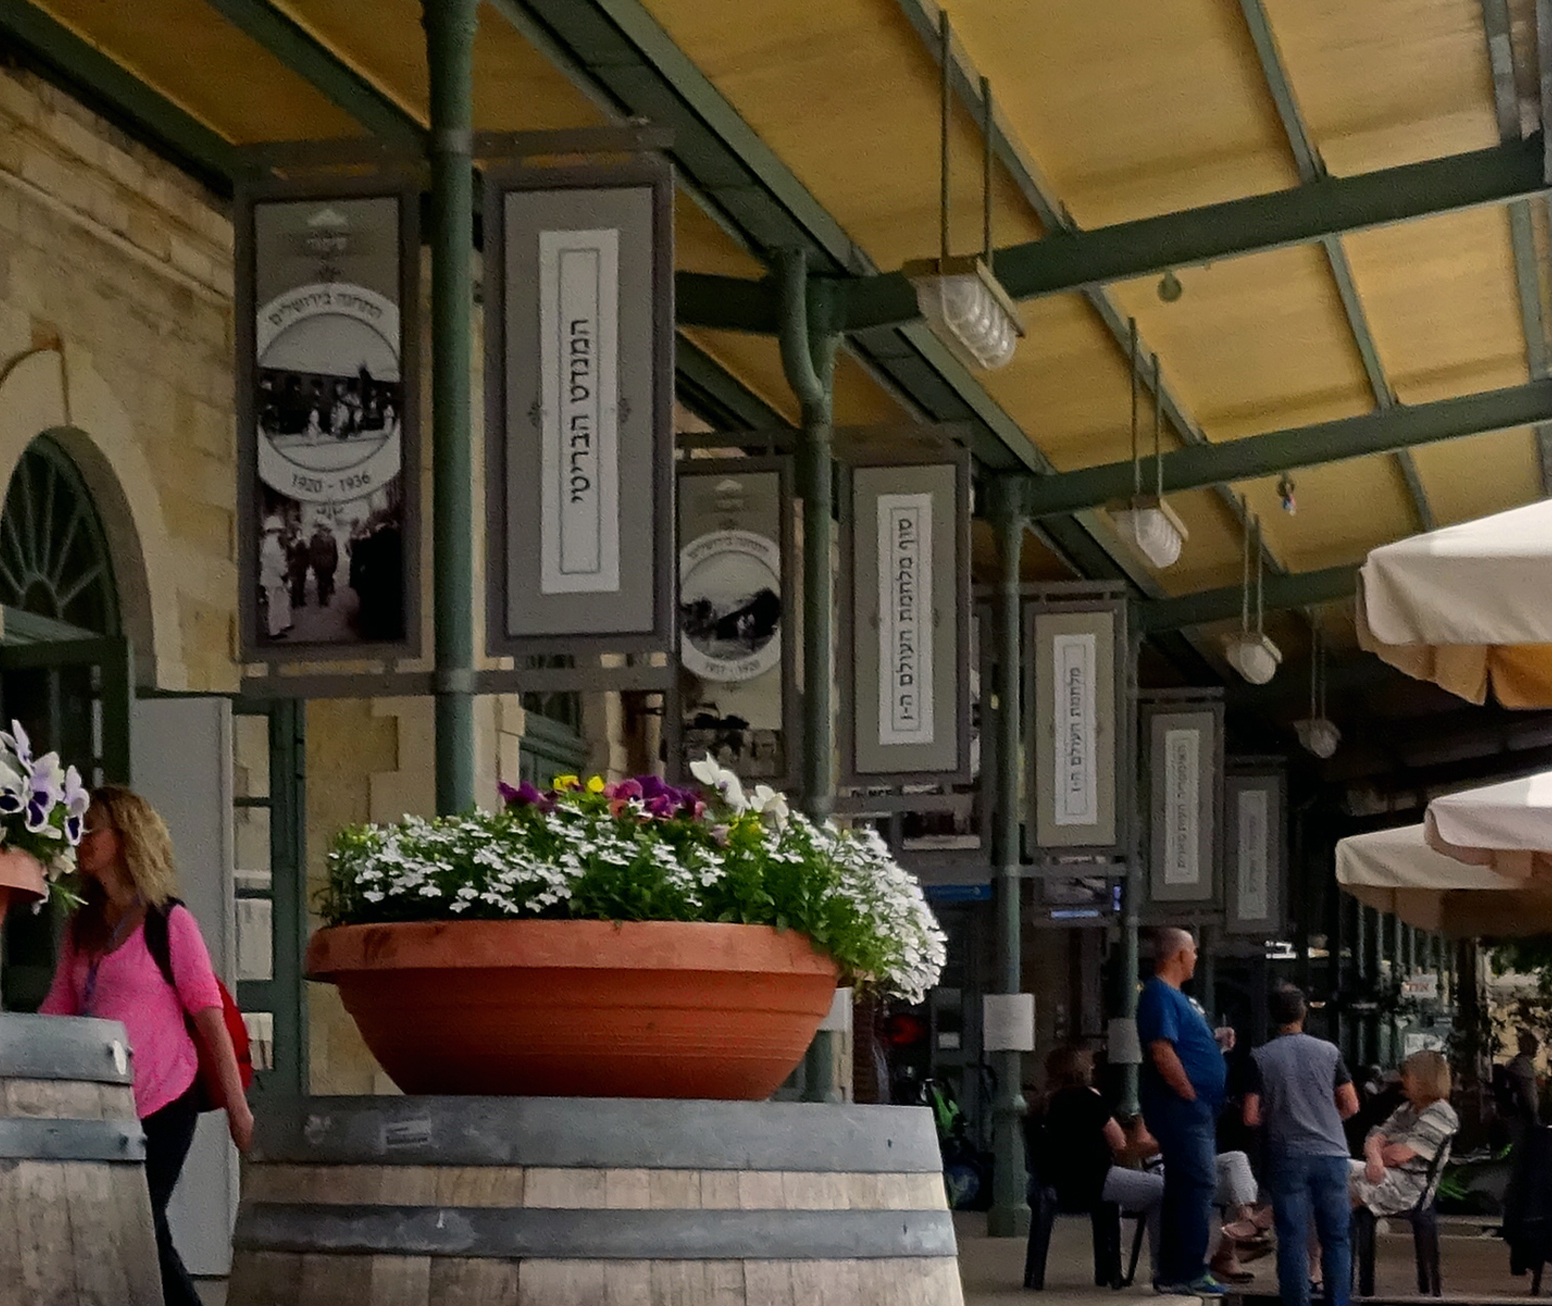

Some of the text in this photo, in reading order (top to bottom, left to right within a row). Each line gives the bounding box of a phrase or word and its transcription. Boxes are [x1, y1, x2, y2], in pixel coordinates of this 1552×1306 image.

[569, 319, 591, 503] המנדט הבריטי
[339, 471, 370, 491] 1936
[897, 518, 915, 550] סוף
[895, 557, 914, 622] מלחמת
[895, 630, 914, 686] העולם
[1068, 667, 1082, 717] מלחמת
[1067, 723, 1082, 766] העולם
